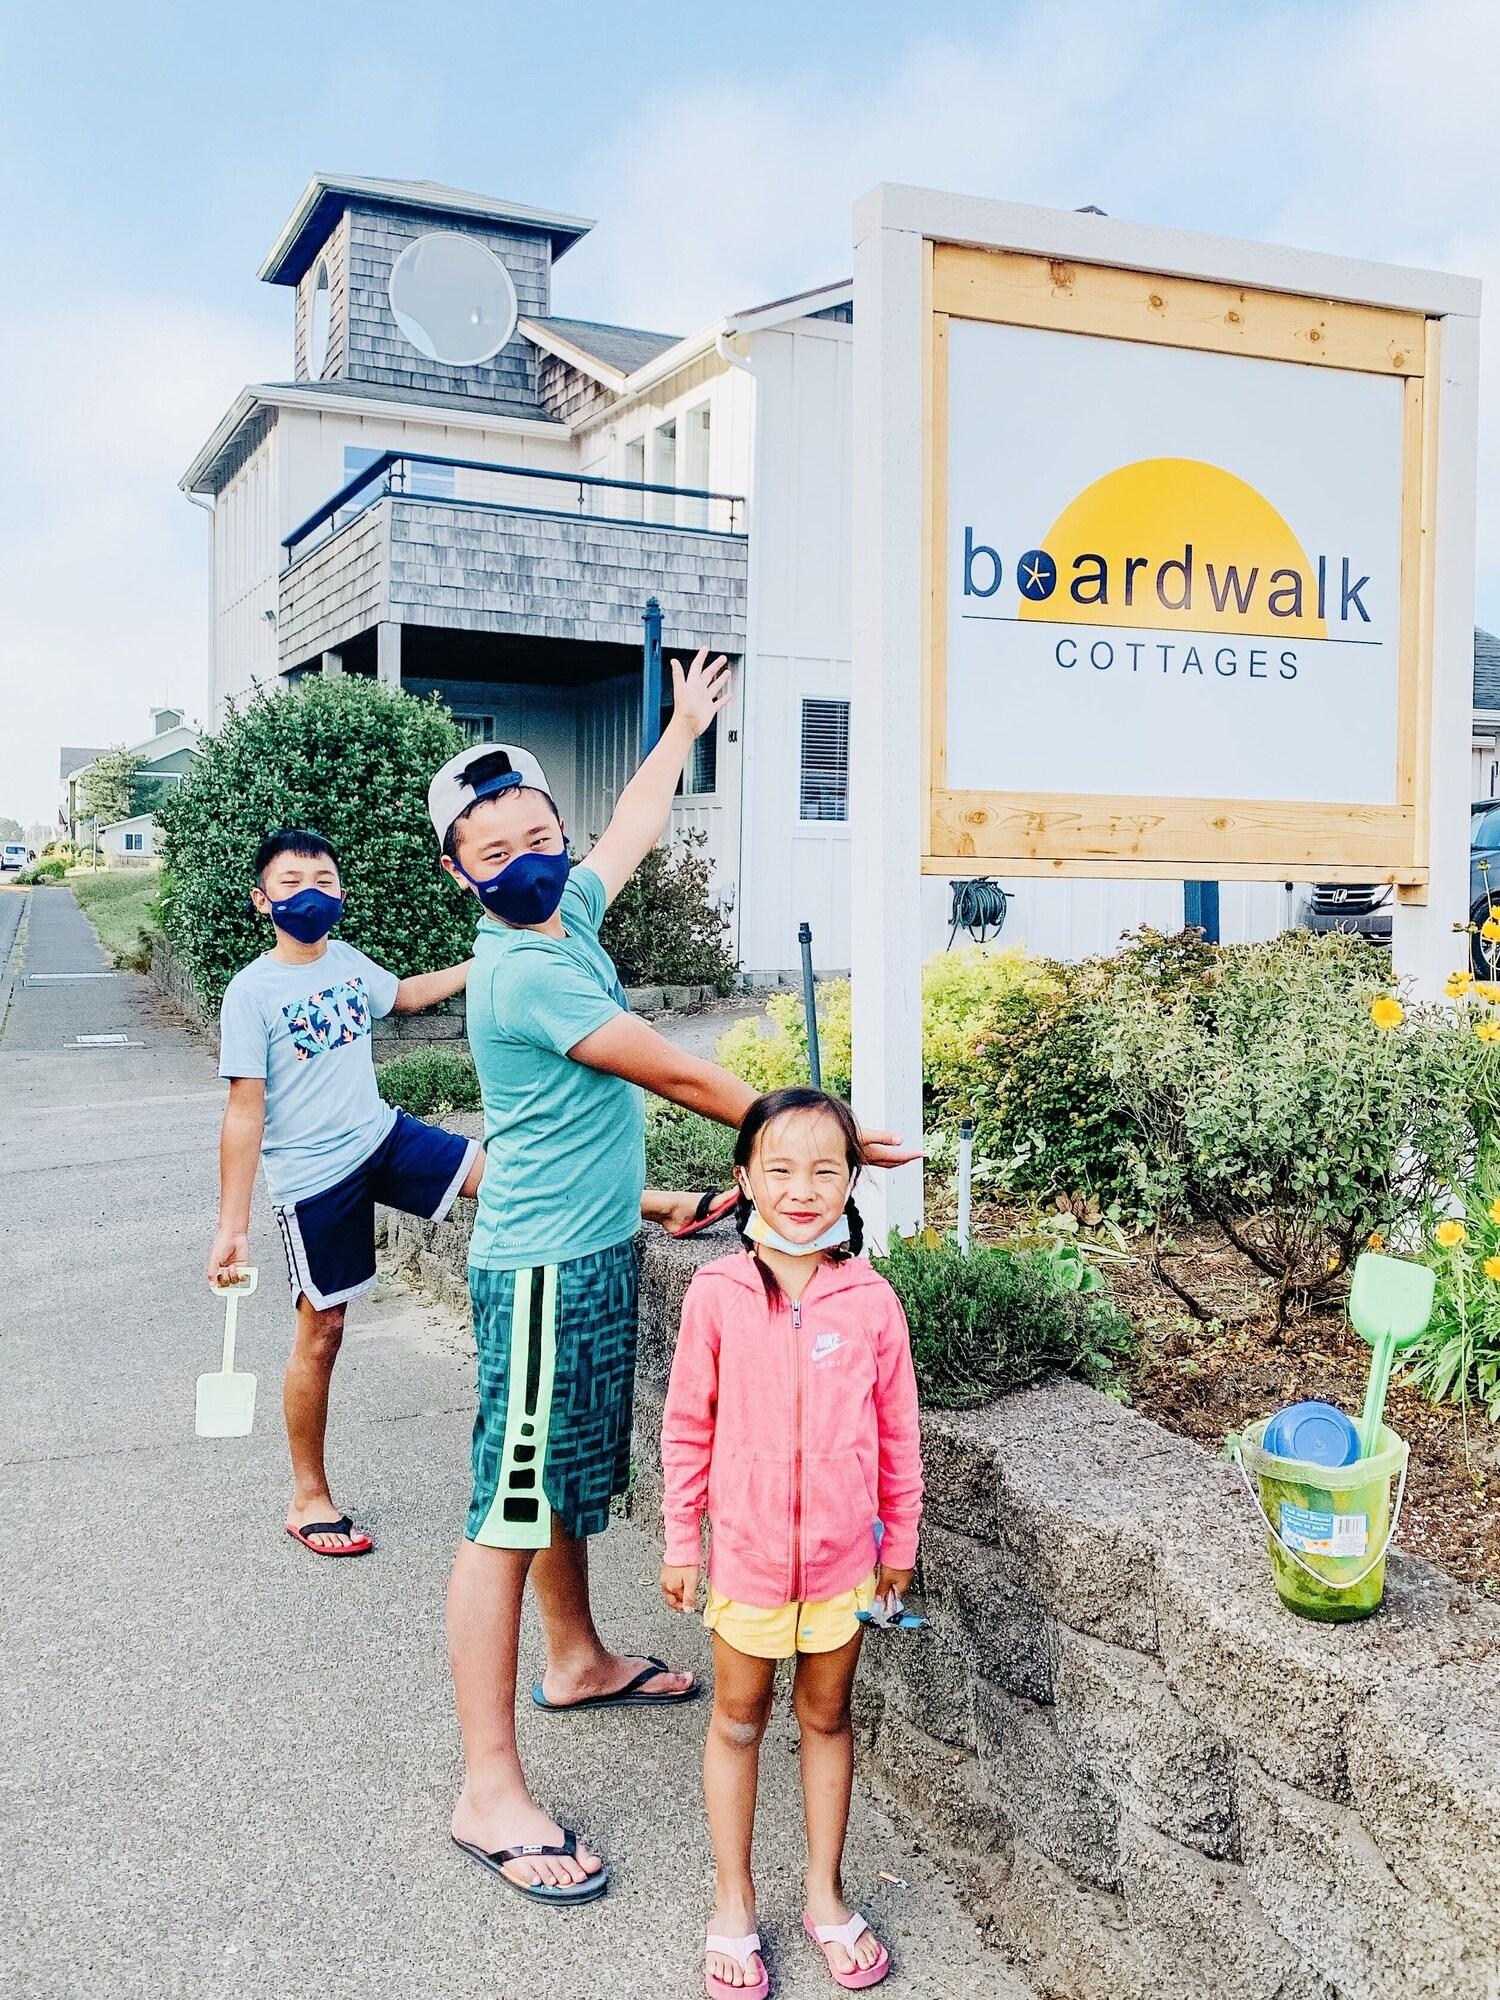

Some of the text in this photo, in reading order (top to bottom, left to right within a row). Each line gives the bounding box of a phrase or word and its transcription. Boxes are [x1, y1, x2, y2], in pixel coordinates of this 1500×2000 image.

[962, 526, 1371, 623] boardwalk
[1055, 638, 1299, 680] COTTAGES
[815, 1332, 841, 1350] NIKE
